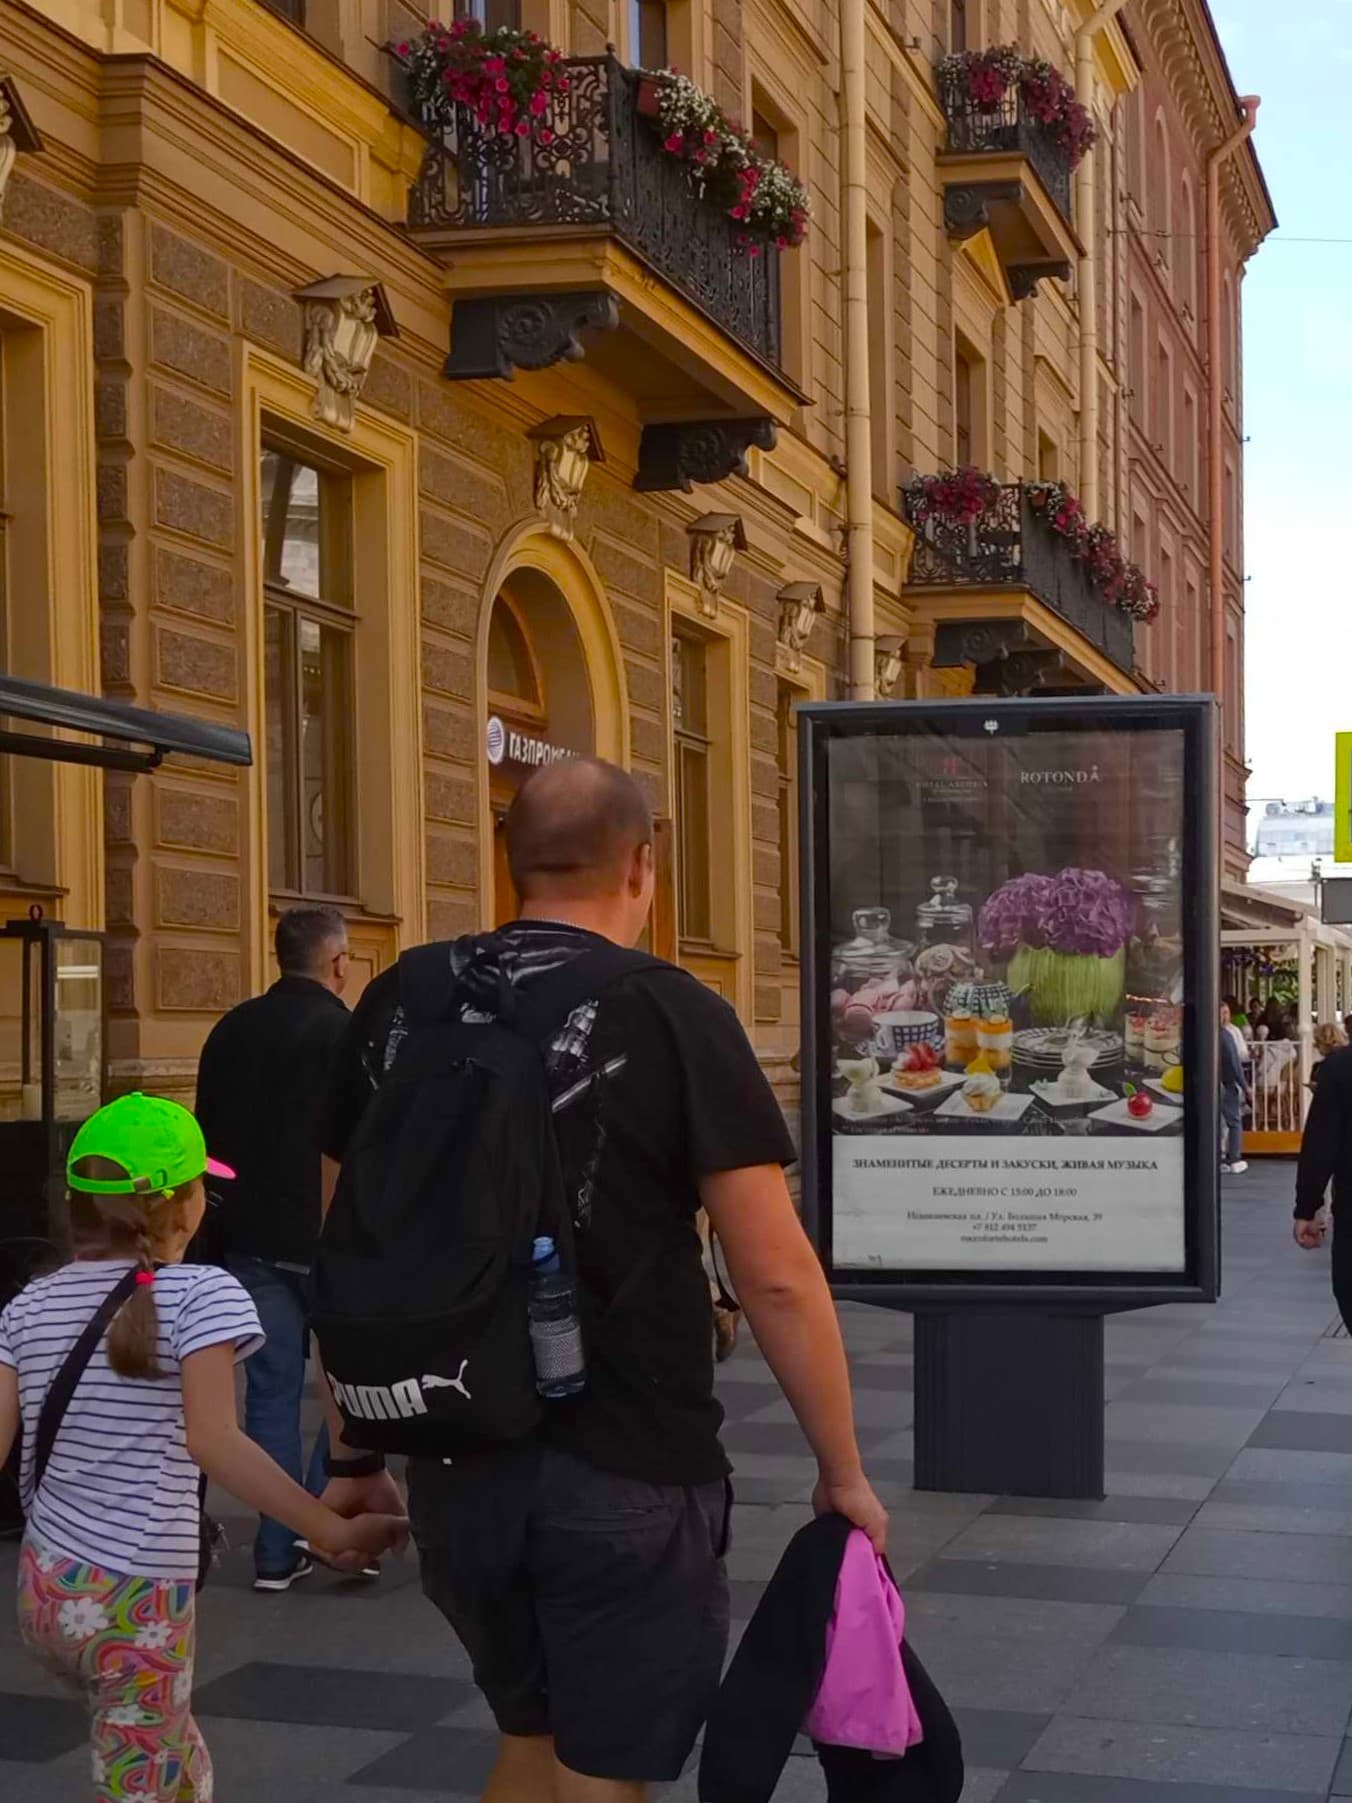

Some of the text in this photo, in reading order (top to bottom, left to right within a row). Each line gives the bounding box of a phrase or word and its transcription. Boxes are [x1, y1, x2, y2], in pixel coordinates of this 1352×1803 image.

[853, 1159, 932, 1169] ЗНАМЕНИТЫЕ
[936, 1159, 988, 1170] ДЕСЕРТЫ
[990, 1159, 1000, 1169] И
[1061, 1160, 1105, 1170] ЖИВАЯ
[1107, 1160, 1159, 1170] МУЗЫКА
[932, 1187, 999, 1197] ЕЖЕДНЕВНО
[1034, 1188, 1051, 1198] ДО
[327, 1371, 428, 1420] PUMA
